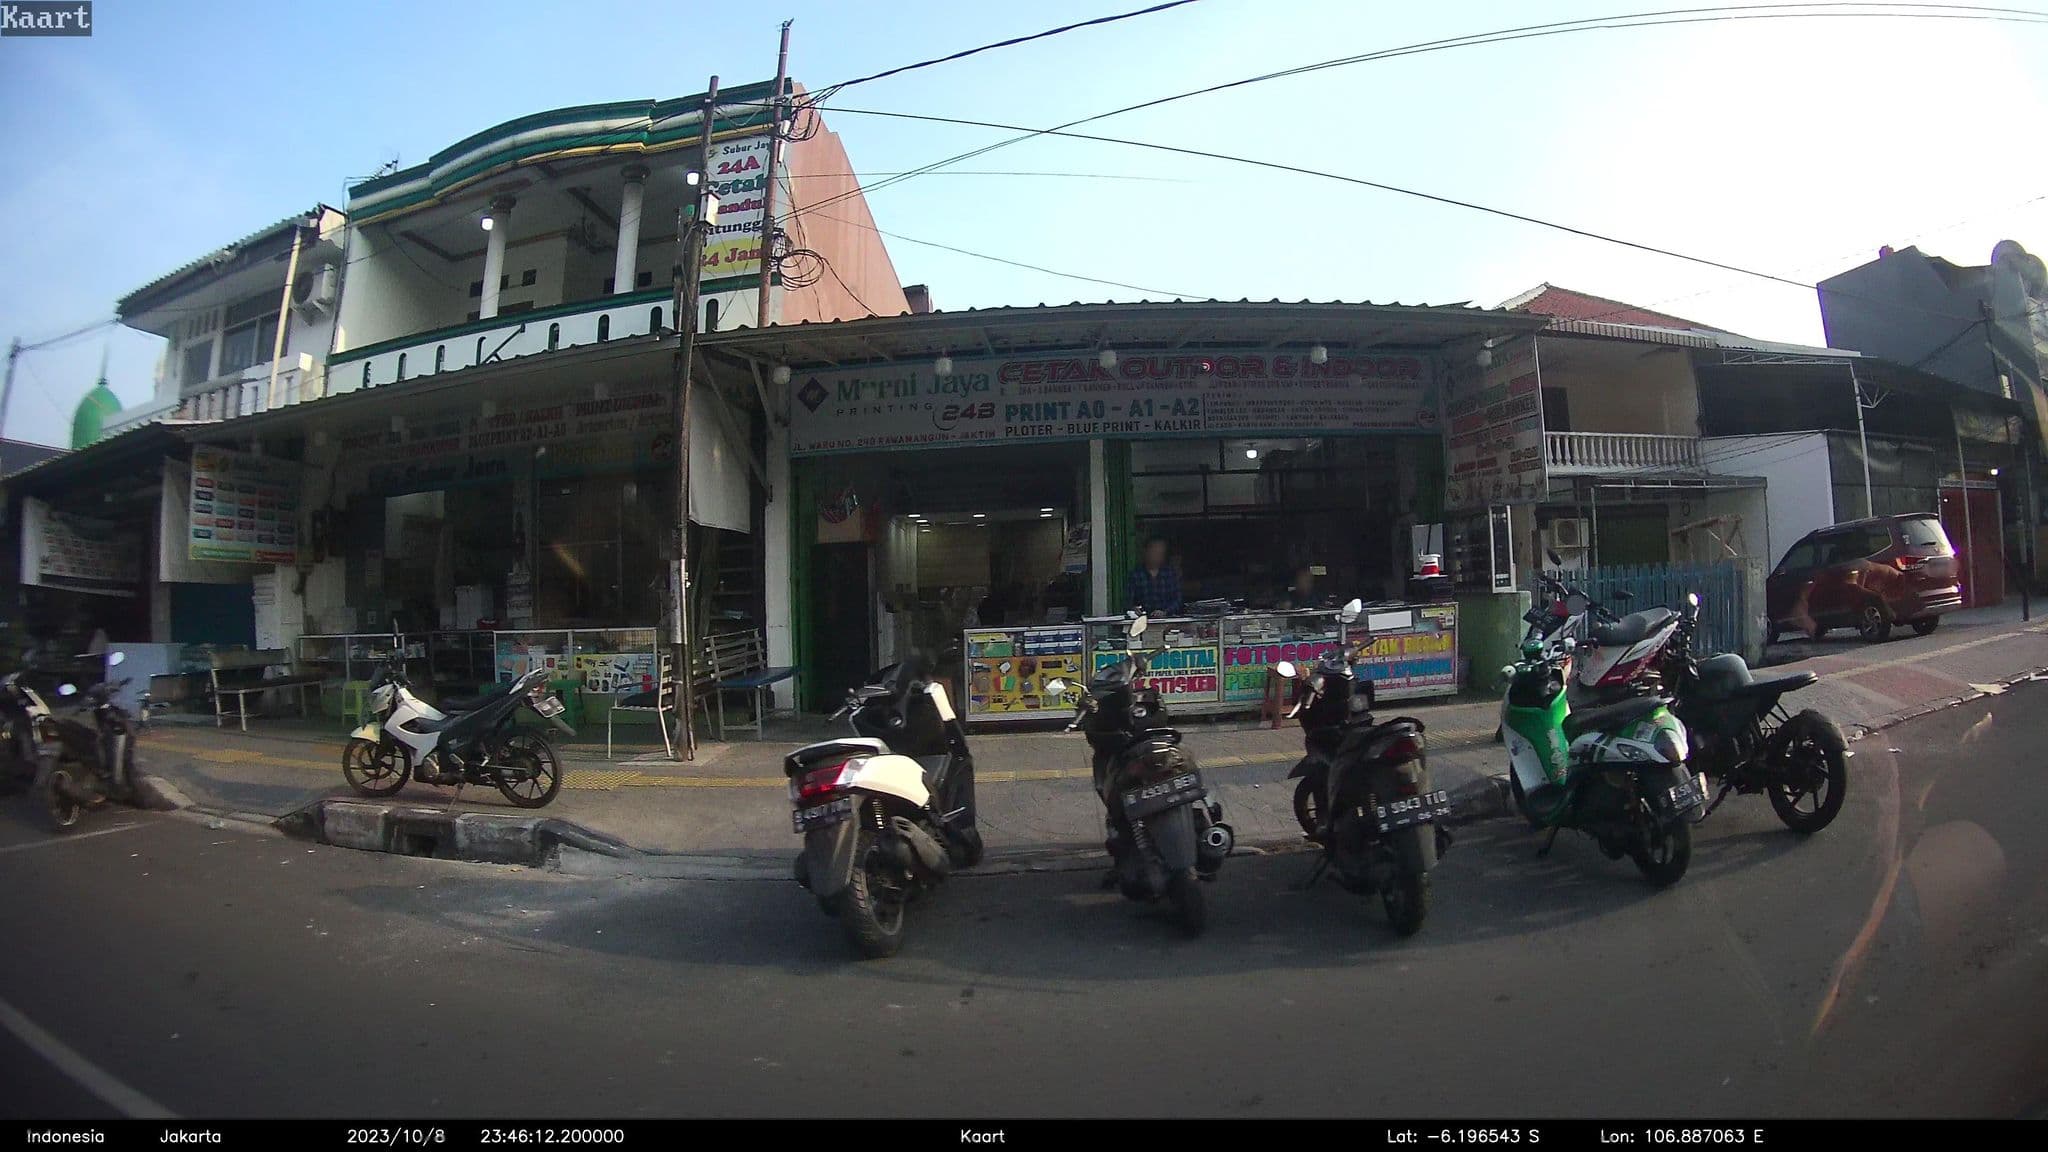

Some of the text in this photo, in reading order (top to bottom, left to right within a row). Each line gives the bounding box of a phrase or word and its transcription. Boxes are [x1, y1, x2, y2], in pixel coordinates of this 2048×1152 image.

[722, 144, 752, 155] Subur
[717, 155, 760, 175] 24A
[997, 357, 1119, 384] CETAK
[927, 372, 989, 398] Jaya
[836, 402, 933, 418] PRINTING
[941, 402, 996, 422] 24B
[1004, 402, 1071, 421] PRINT
[1077, 400, 1105, 419] A0
[1129, 399, 1154, 417] A1
[1171, 398, 1201, 417] A2
[1005, 425, 1053, 437] PLOTER
[1068, 423, 1099, 434] BLUE
[1103, 421, 1141, 433] PRINT
[1154, 419, 1200, 431] KALKIR
[878, 432, 949, 445] RAWAMANGUN
[1150, 649, 1216, 670] DIGITAL
[1150, 675, 1217, 693] STICKER
